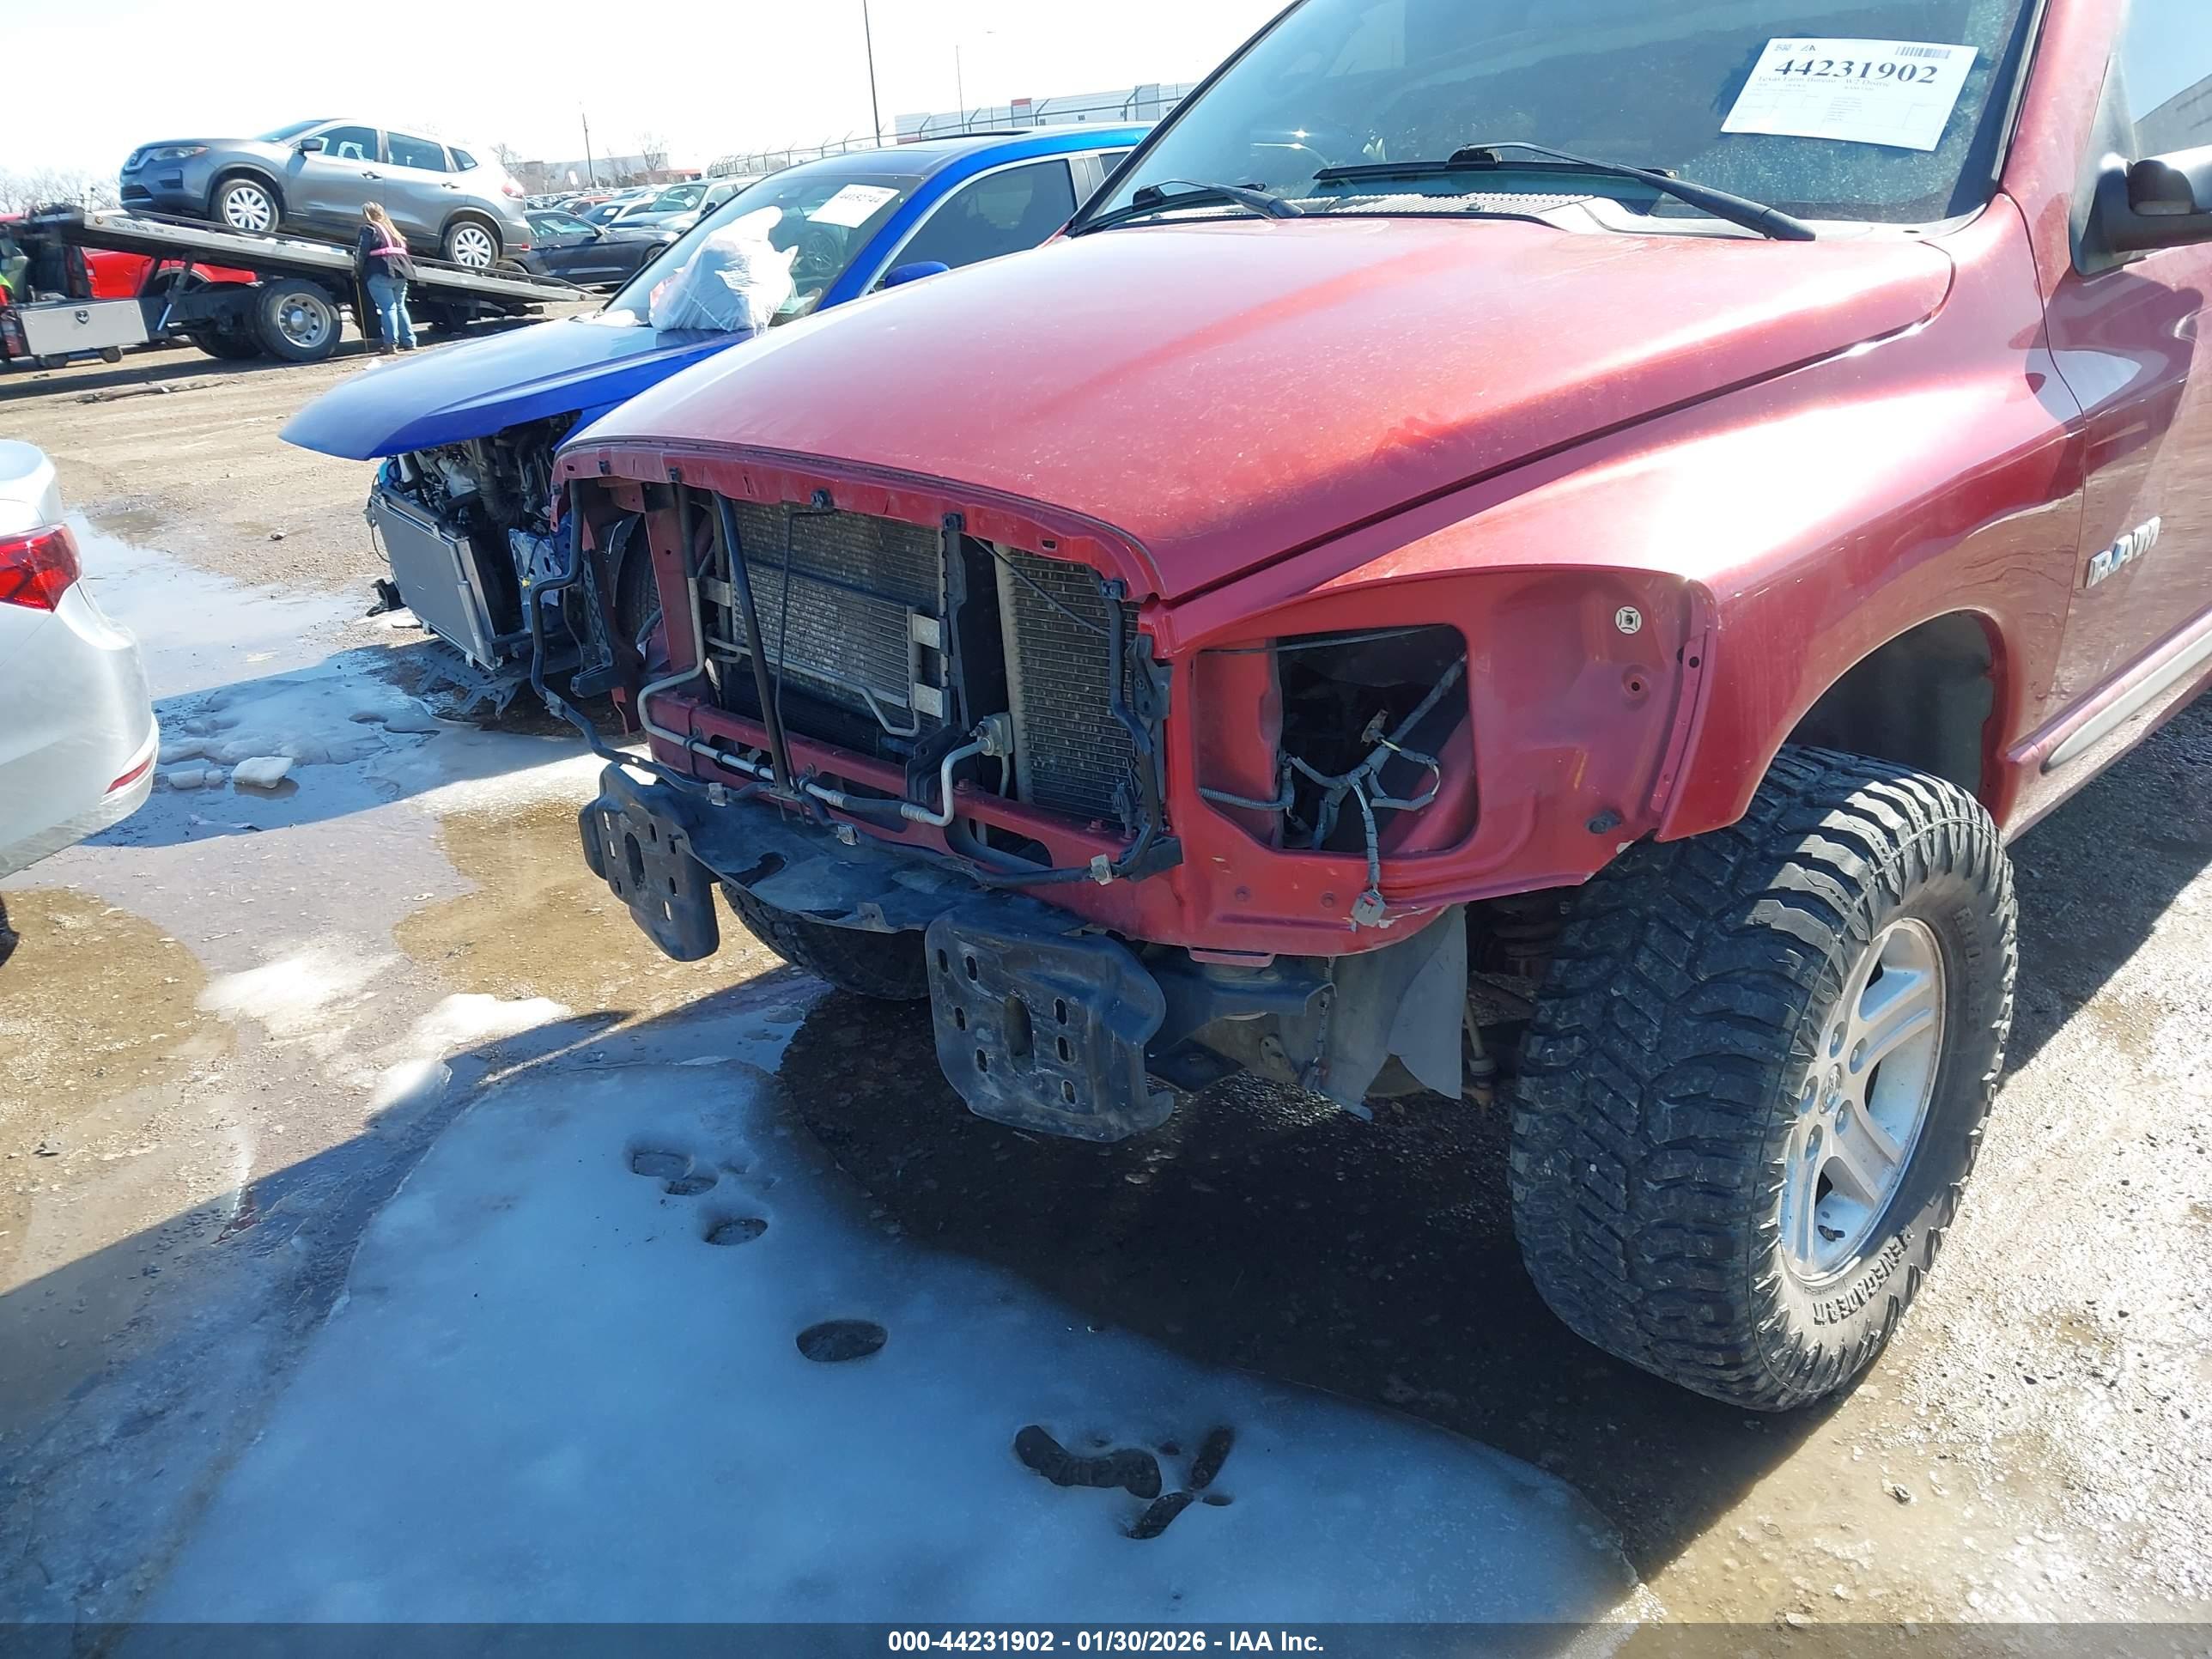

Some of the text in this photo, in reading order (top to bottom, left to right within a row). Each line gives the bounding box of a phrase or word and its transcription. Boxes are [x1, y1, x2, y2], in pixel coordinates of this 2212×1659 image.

[1774, 58, 1938, 84] 44231902
[2084, 516, 2161, 589] RAM
[1837, 1224, 1915, 1319] RENEGADE
